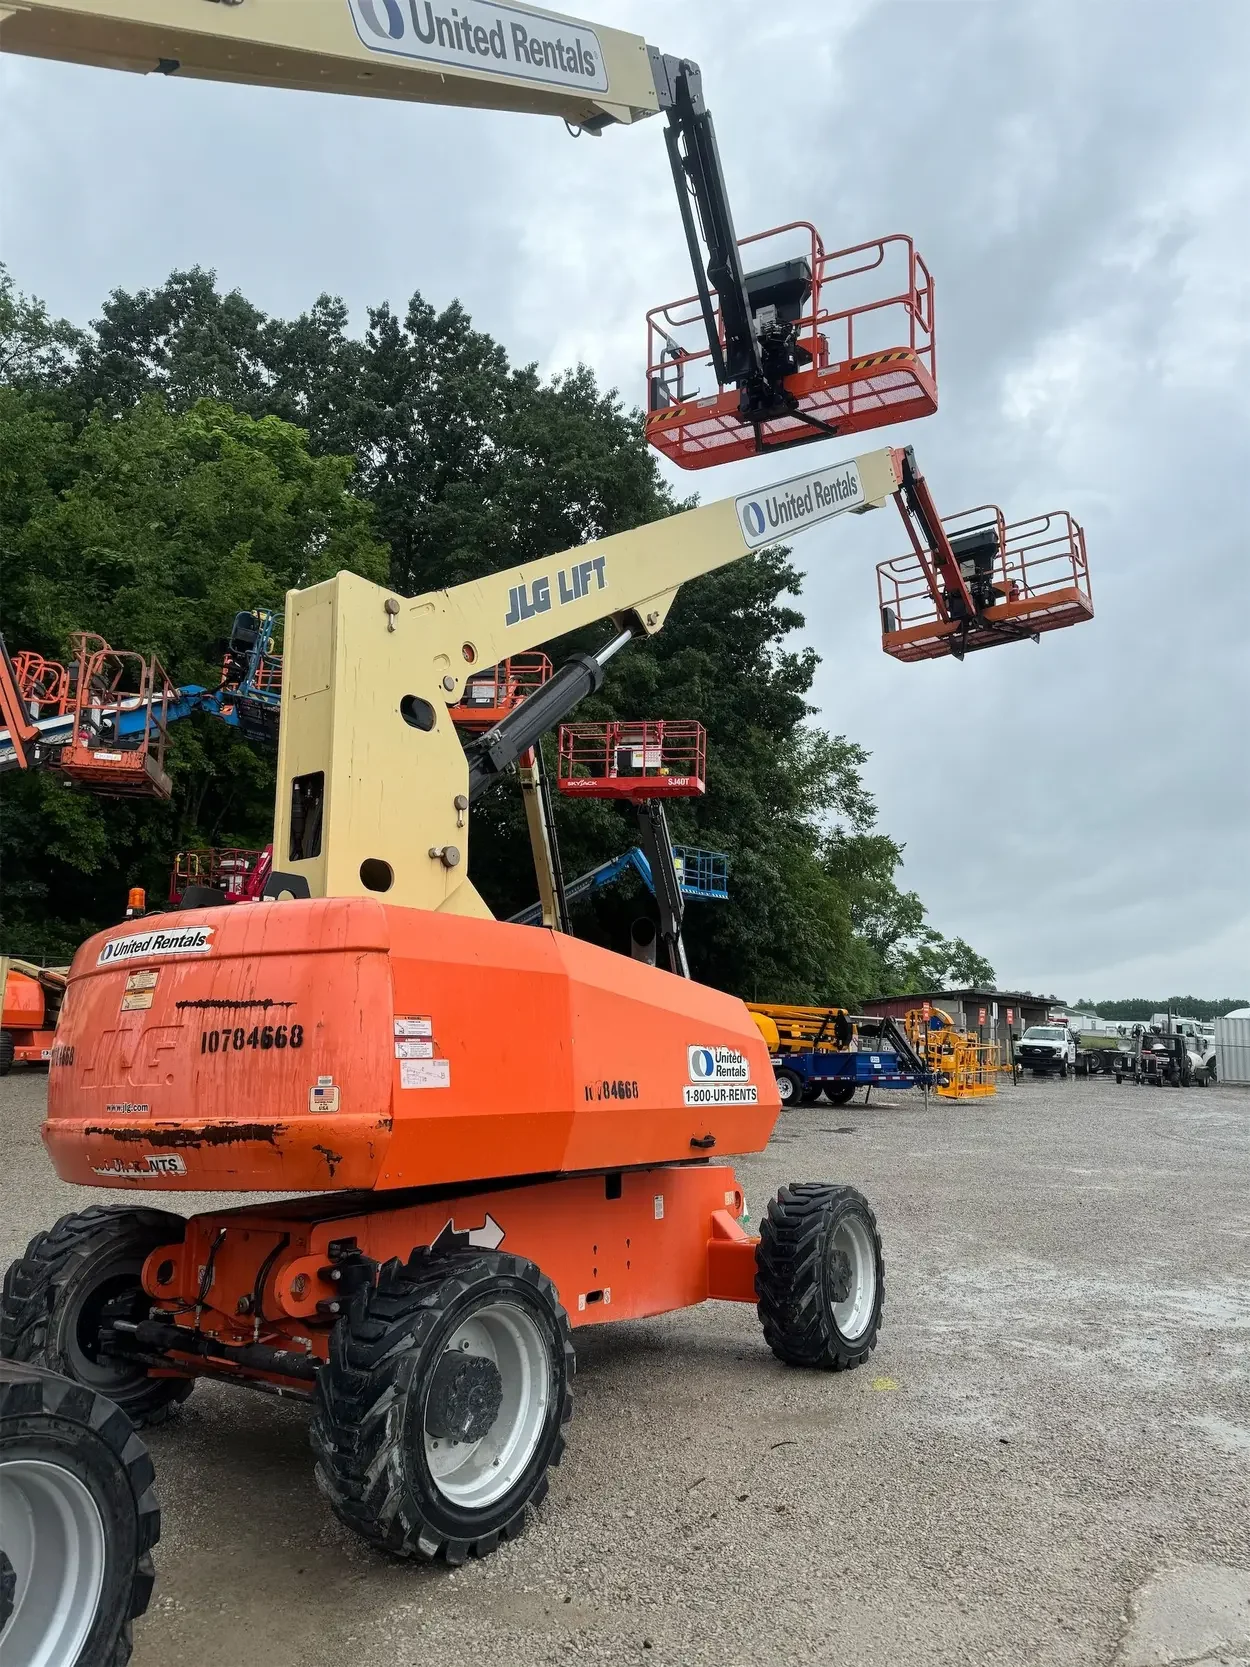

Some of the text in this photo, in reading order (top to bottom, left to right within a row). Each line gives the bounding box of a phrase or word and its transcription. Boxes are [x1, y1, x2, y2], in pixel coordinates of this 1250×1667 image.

[409, 0, 596, 77] United Rentals
[765, 471, 858, 528] United Rentals
[505, 555, 606, 628] JLG LIFT
[567, 778, 690, 787] SKYJACK SJ40T
[113, 932, 206, 957] United Rentals
[201, 1025, 304, 1055] 10784668
[715, 1051, 743, 1064] United
[716, 1065, 747, 1077] Rentals
[686, 1088, 757, 1102] 1-800-UR-RENTS
[106, 1103, 149, 1113] www.jlg.com
